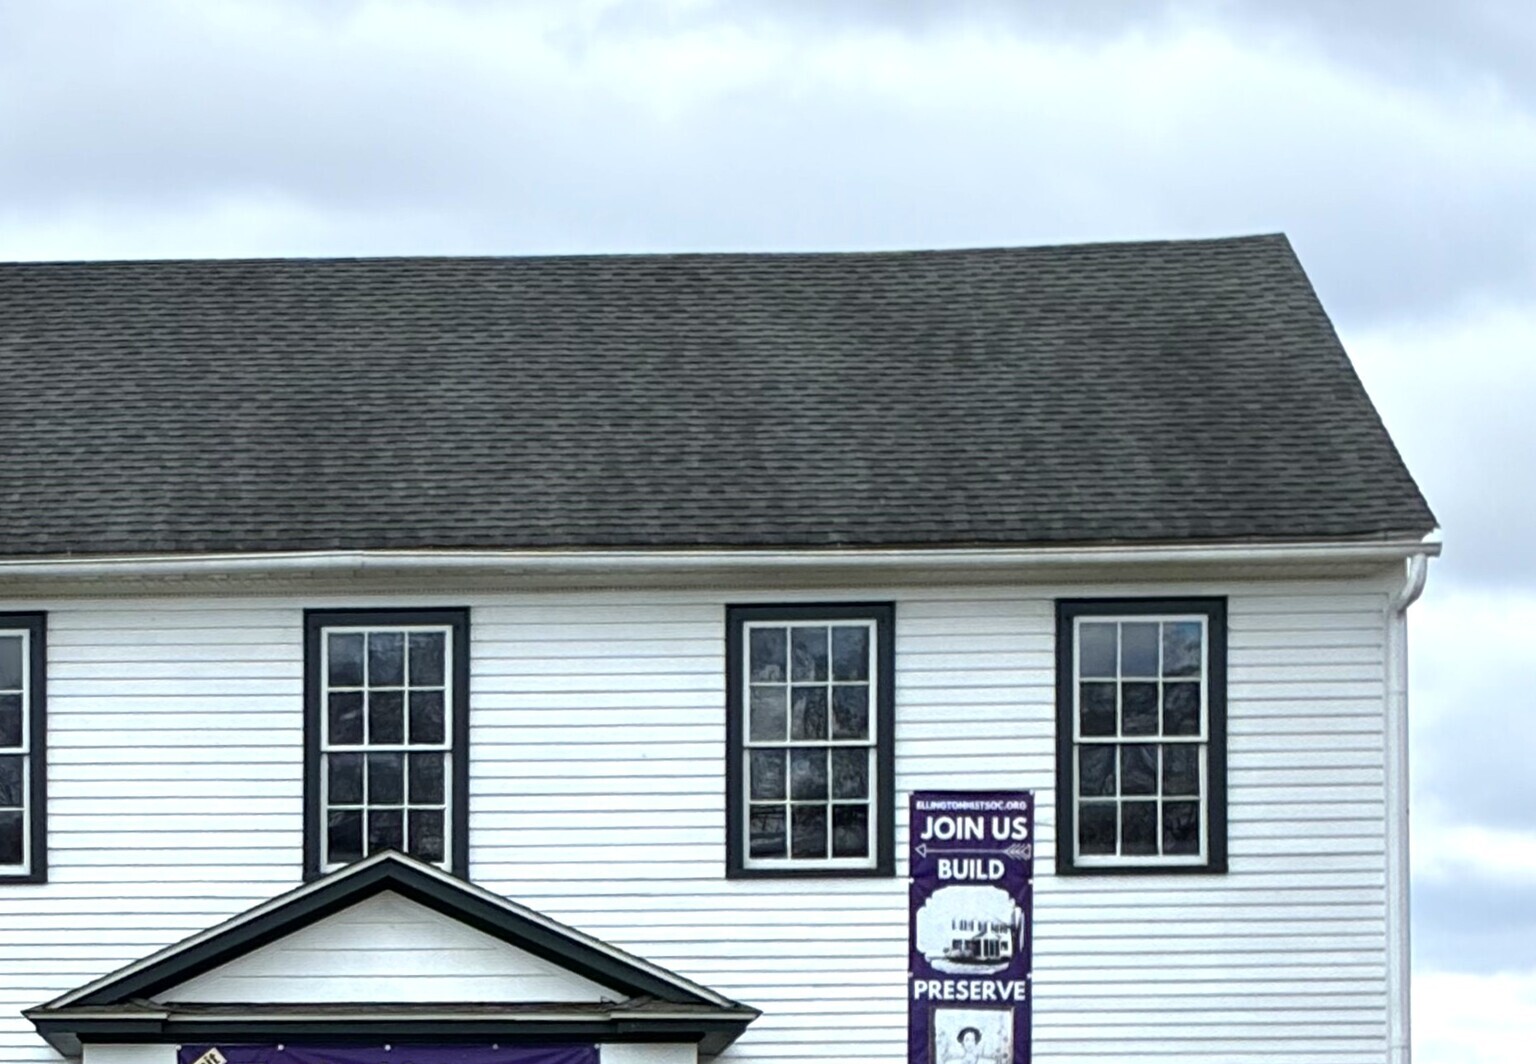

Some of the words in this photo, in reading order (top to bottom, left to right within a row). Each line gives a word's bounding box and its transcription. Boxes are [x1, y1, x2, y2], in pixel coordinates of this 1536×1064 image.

[920, 816, 985, 840] JOIN
[991, 816, 1028, 840] US
[937, 858, 1005, 880] BUILD
[914, 980, 1026, 1001] PRESERVE
